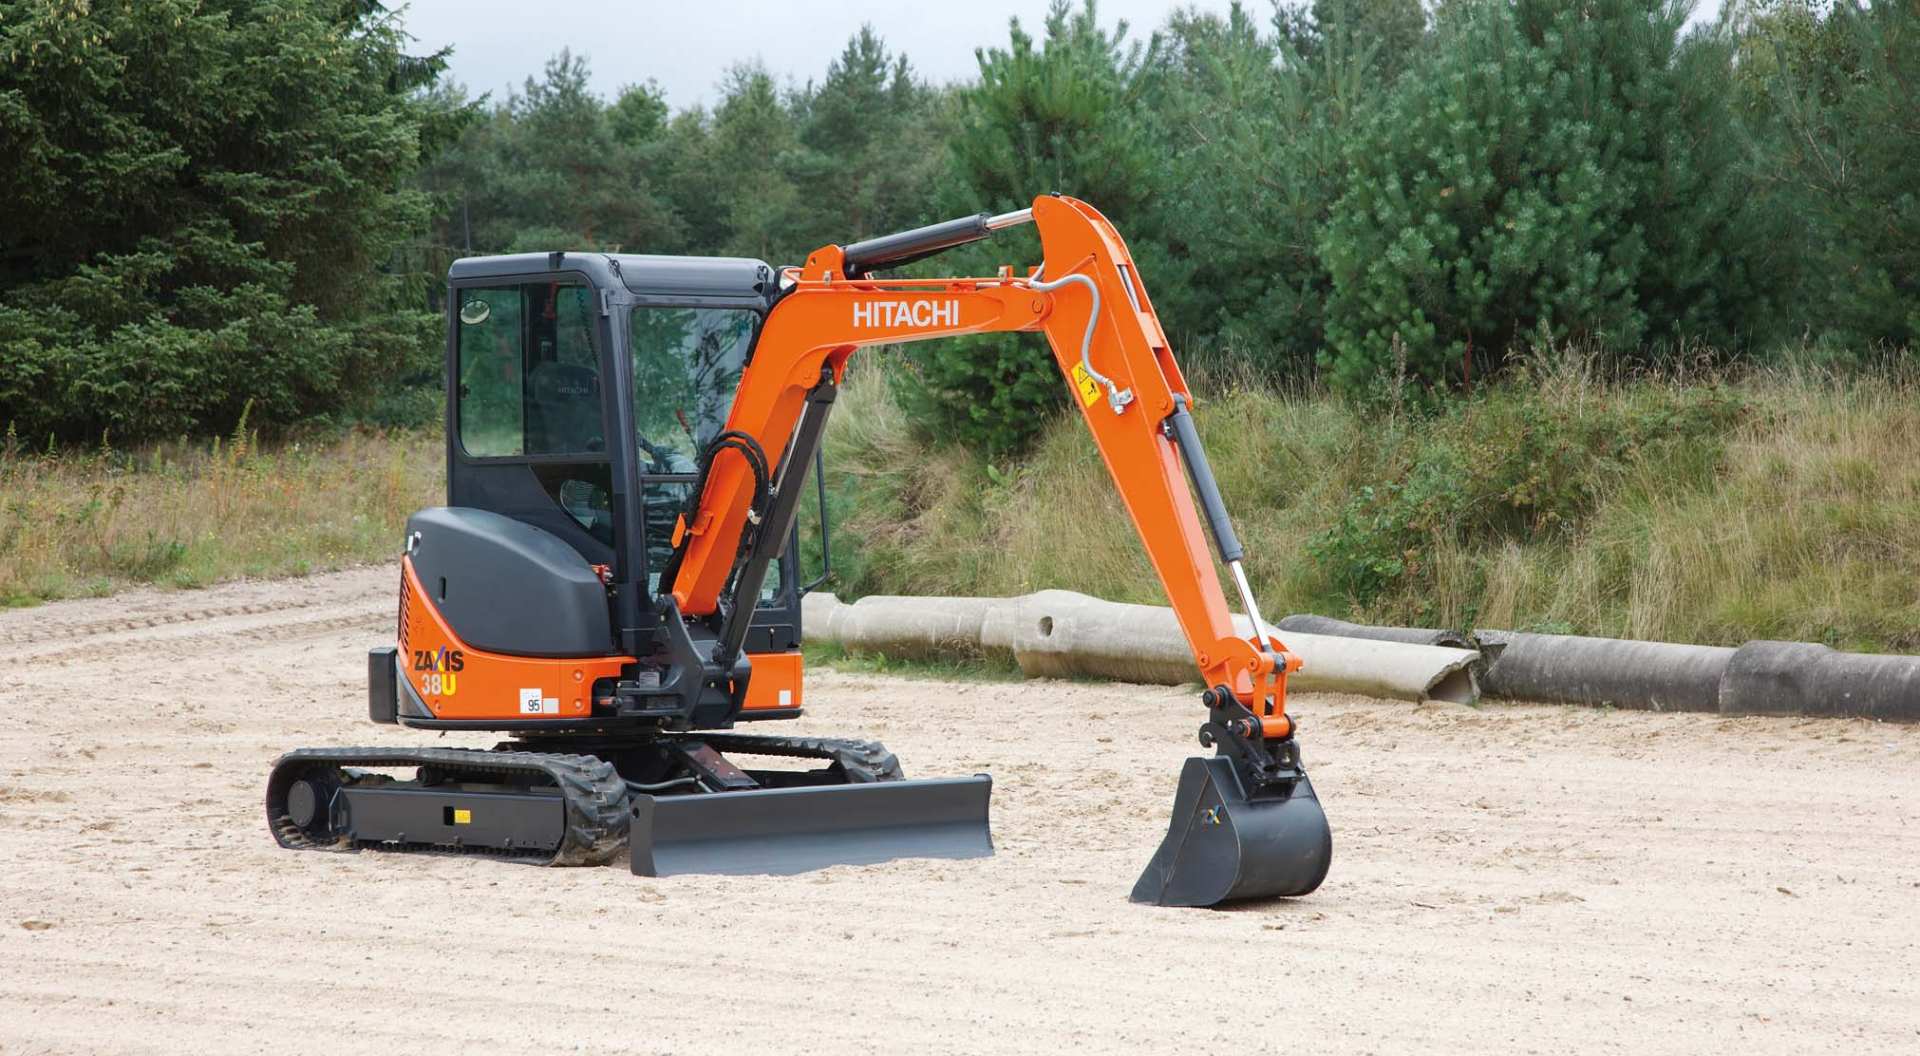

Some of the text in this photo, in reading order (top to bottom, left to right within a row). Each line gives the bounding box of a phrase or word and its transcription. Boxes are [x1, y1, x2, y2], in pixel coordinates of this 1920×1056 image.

[853, 300, 959, 327] HITACHI
[415, 646, 464, 672] ZAXIS
[421, 673, 457, 696] 38U
[528, 699, 540, 712] 95
